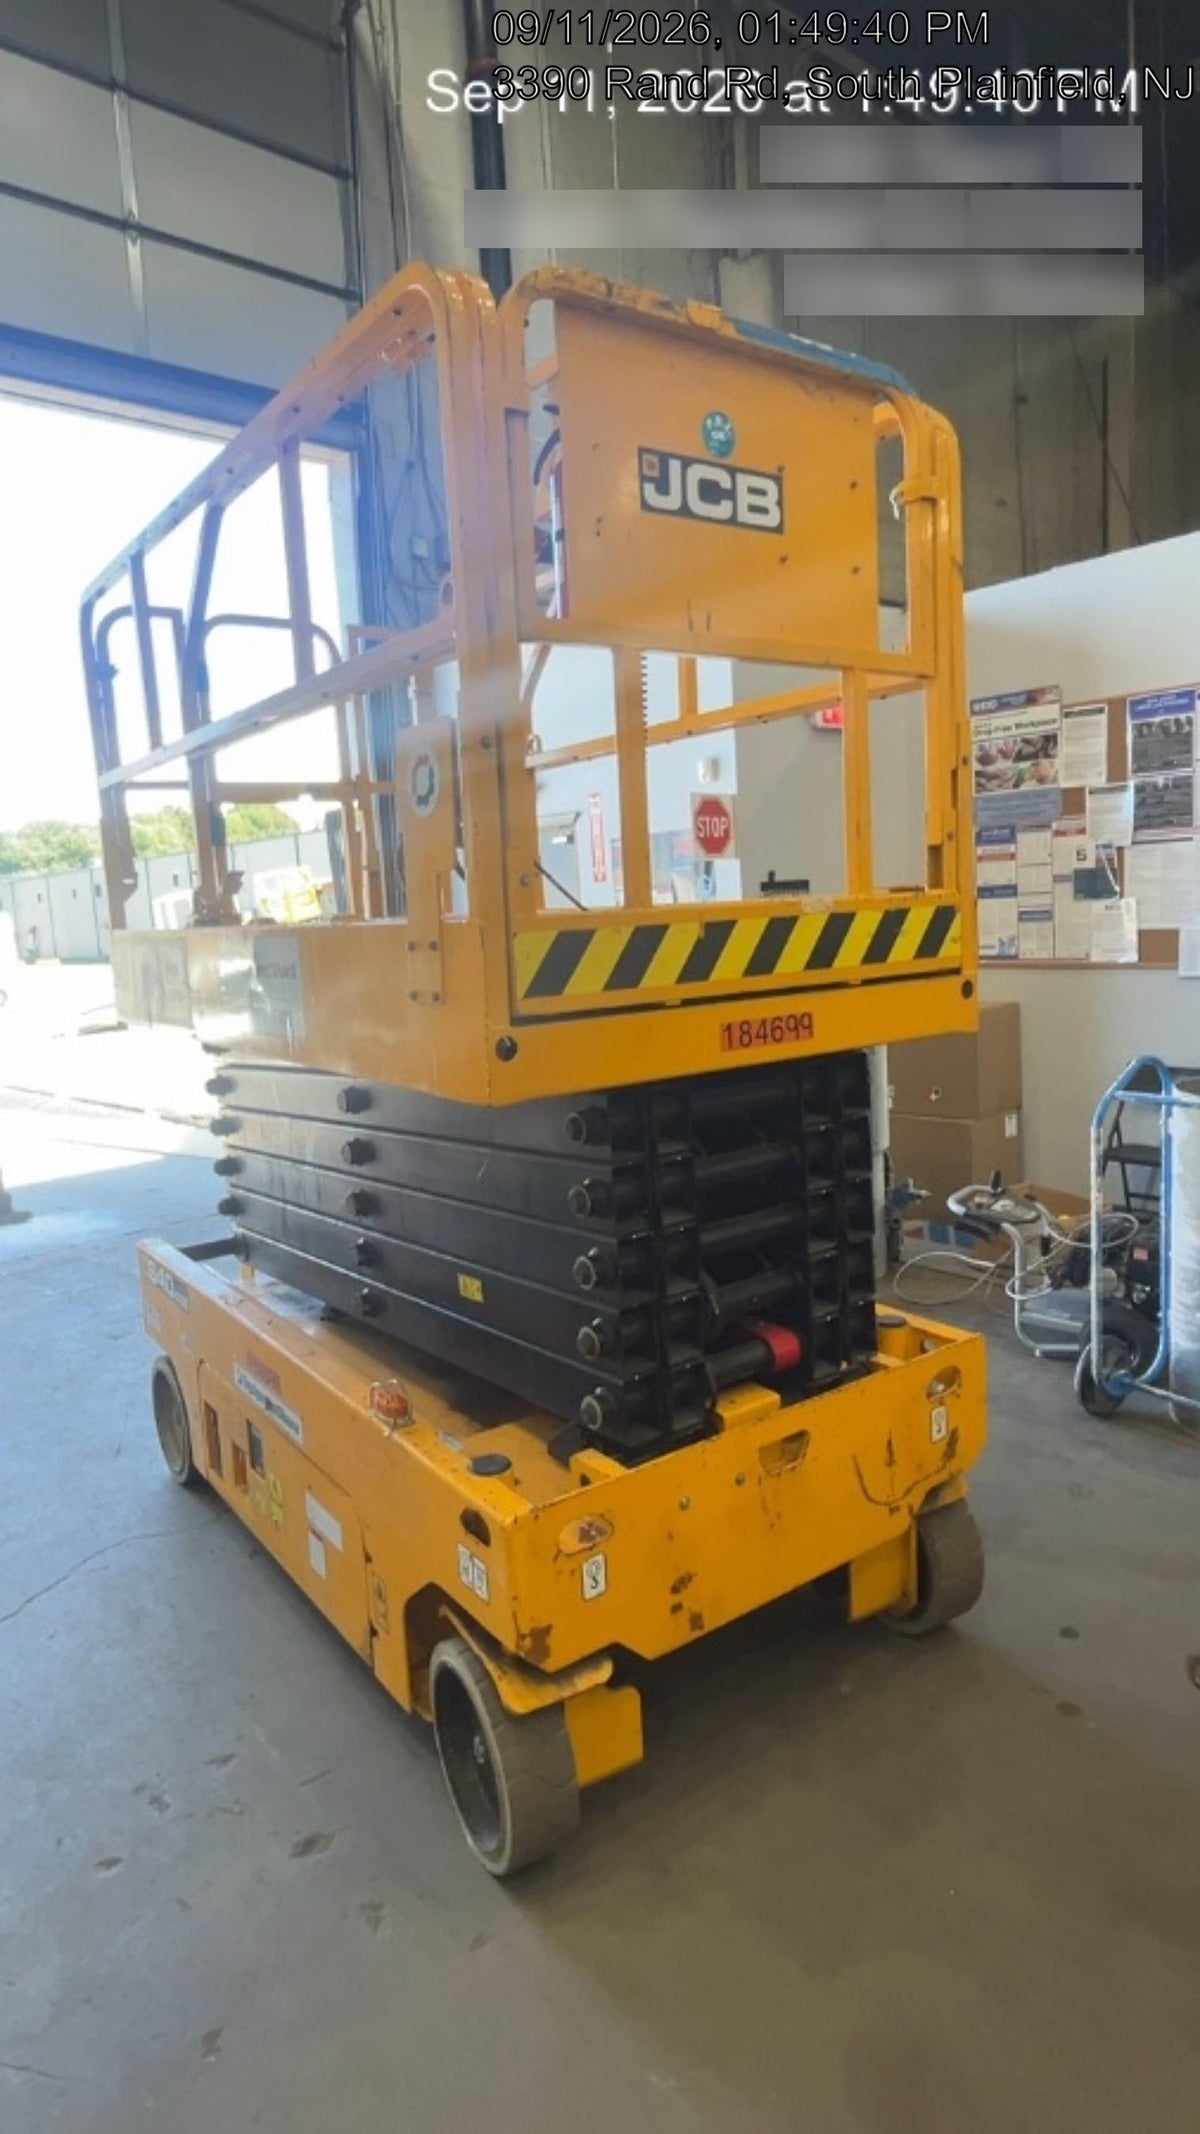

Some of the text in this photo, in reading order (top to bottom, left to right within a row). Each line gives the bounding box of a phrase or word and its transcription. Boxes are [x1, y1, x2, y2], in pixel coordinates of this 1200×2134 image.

[643, 458, 781, 528] JCB
[696, 816, 730, 839] STOP
[721, 1011, 815, 1050] 184699
